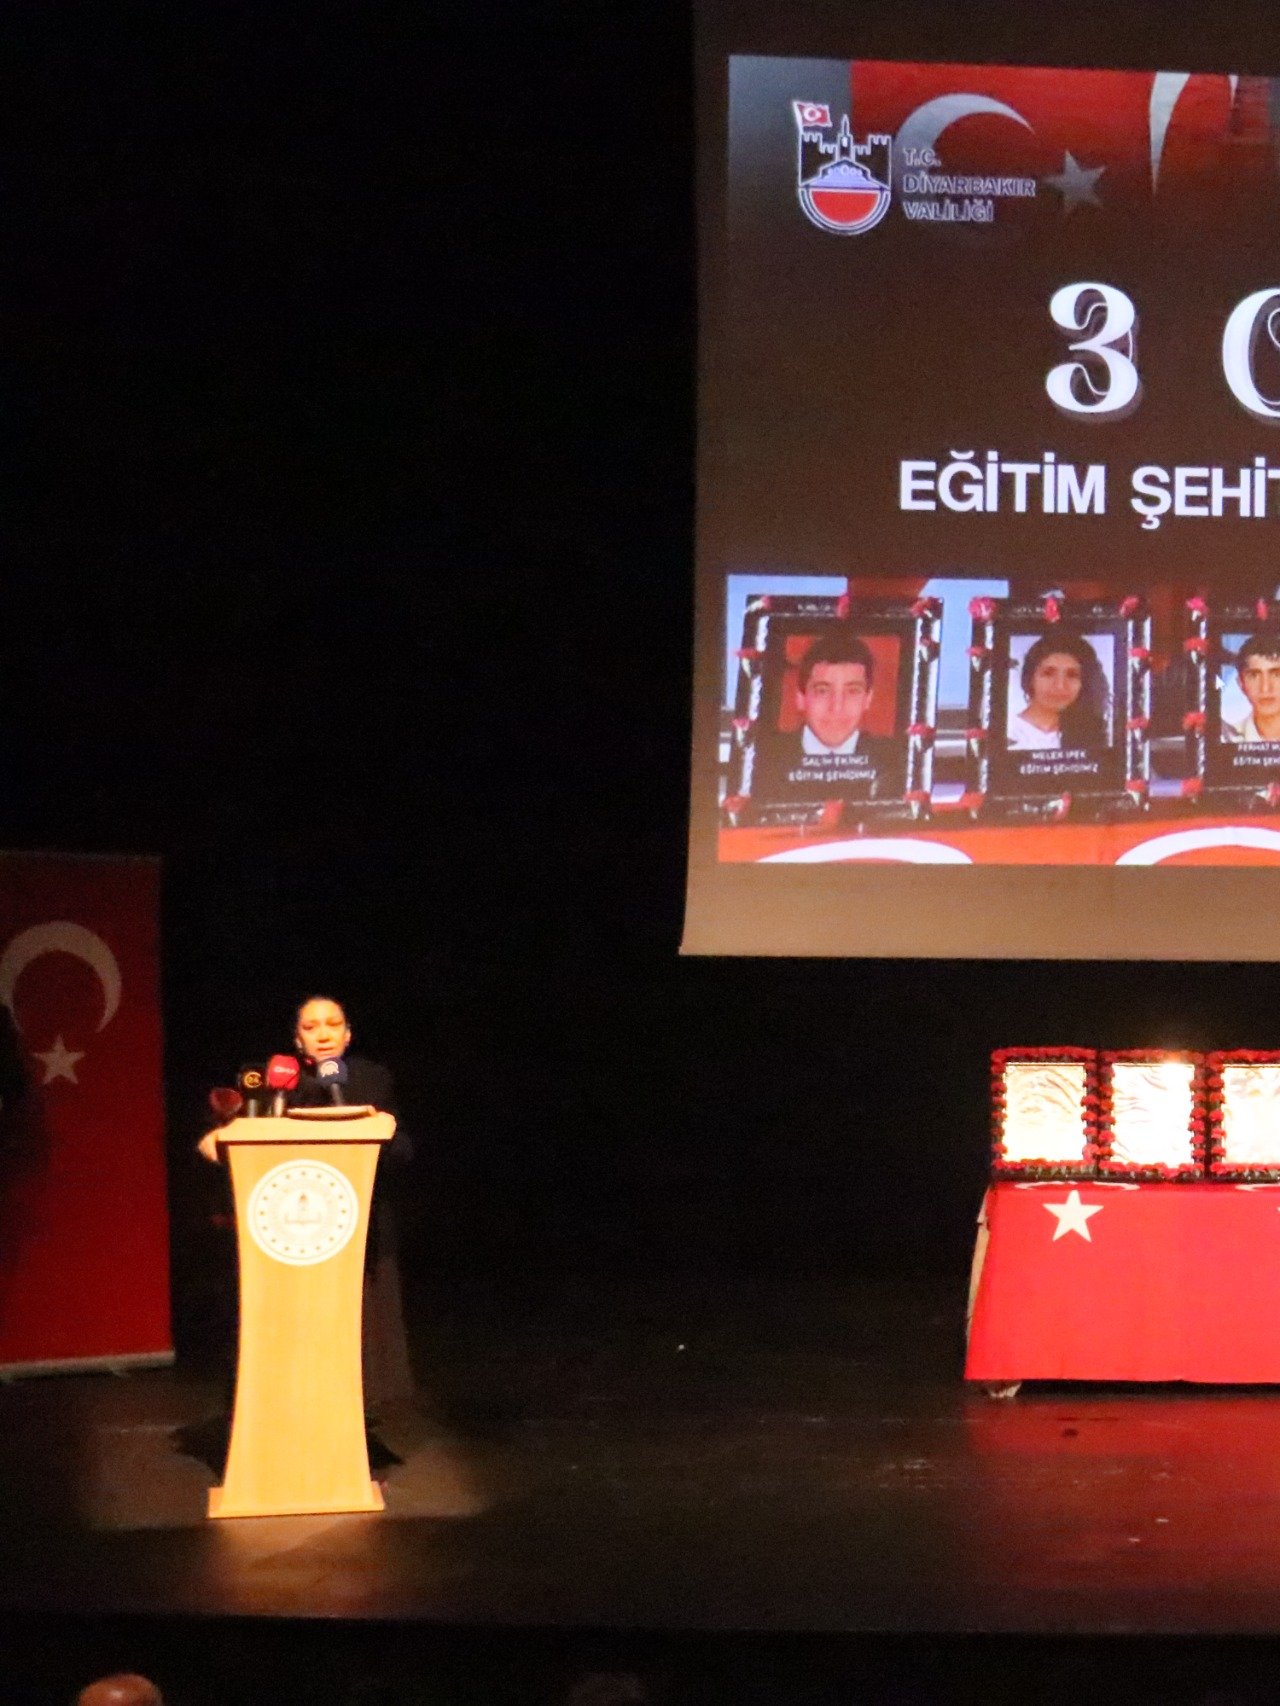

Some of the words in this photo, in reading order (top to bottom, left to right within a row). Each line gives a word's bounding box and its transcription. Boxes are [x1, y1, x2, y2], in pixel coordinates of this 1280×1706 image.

[903, 147, 942, 167] T.C.
[903, 170, 1036, 197] DİYARBAKIR
[903, 198, 994, 222] VALİLİĞİ
[1045, 282, 1139, 414] 3
[900, 450, 1106, 515] EĞİTİM
